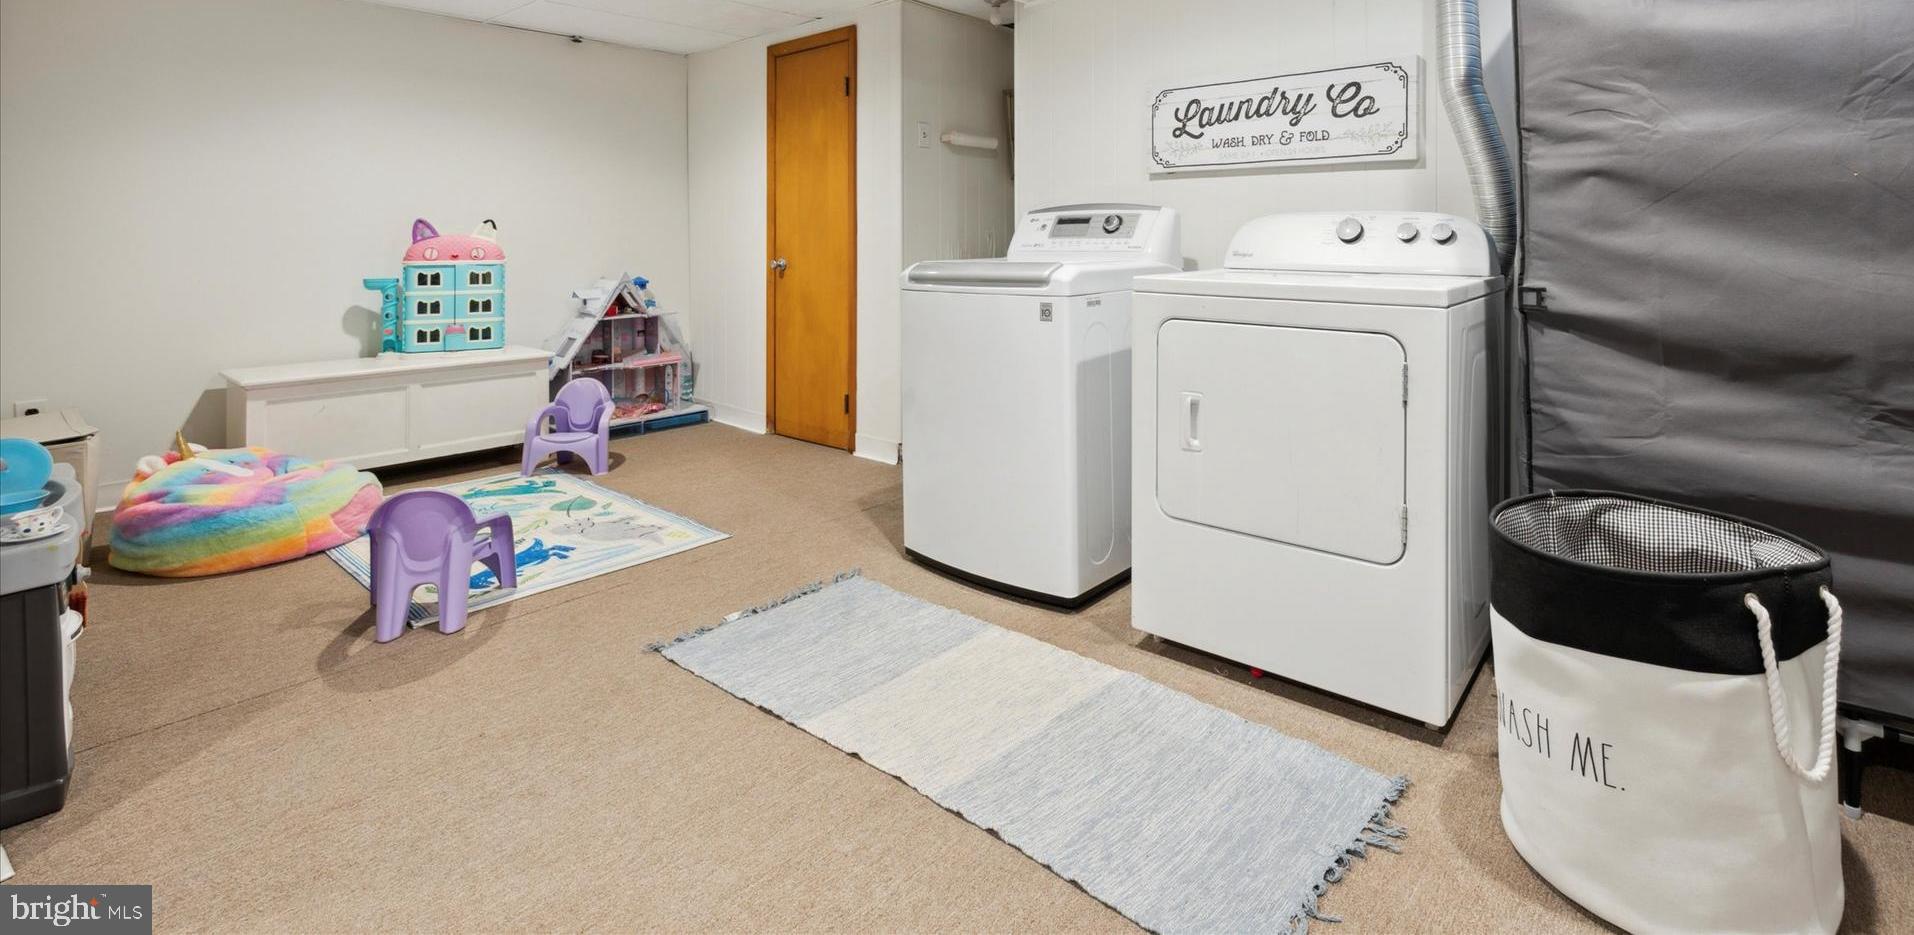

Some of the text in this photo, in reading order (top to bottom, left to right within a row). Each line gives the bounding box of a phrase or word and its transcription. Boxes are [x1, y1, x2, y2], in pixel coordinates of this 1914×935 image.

[1172, 81, 1380, 139] Laundry Co
[1251, 134, 1274, 146] DRY
[1279, 130, 1295, 146] &
[1299, 130, 1330, 142] FOLD
[1571, 732, 1625, 791] ME.
